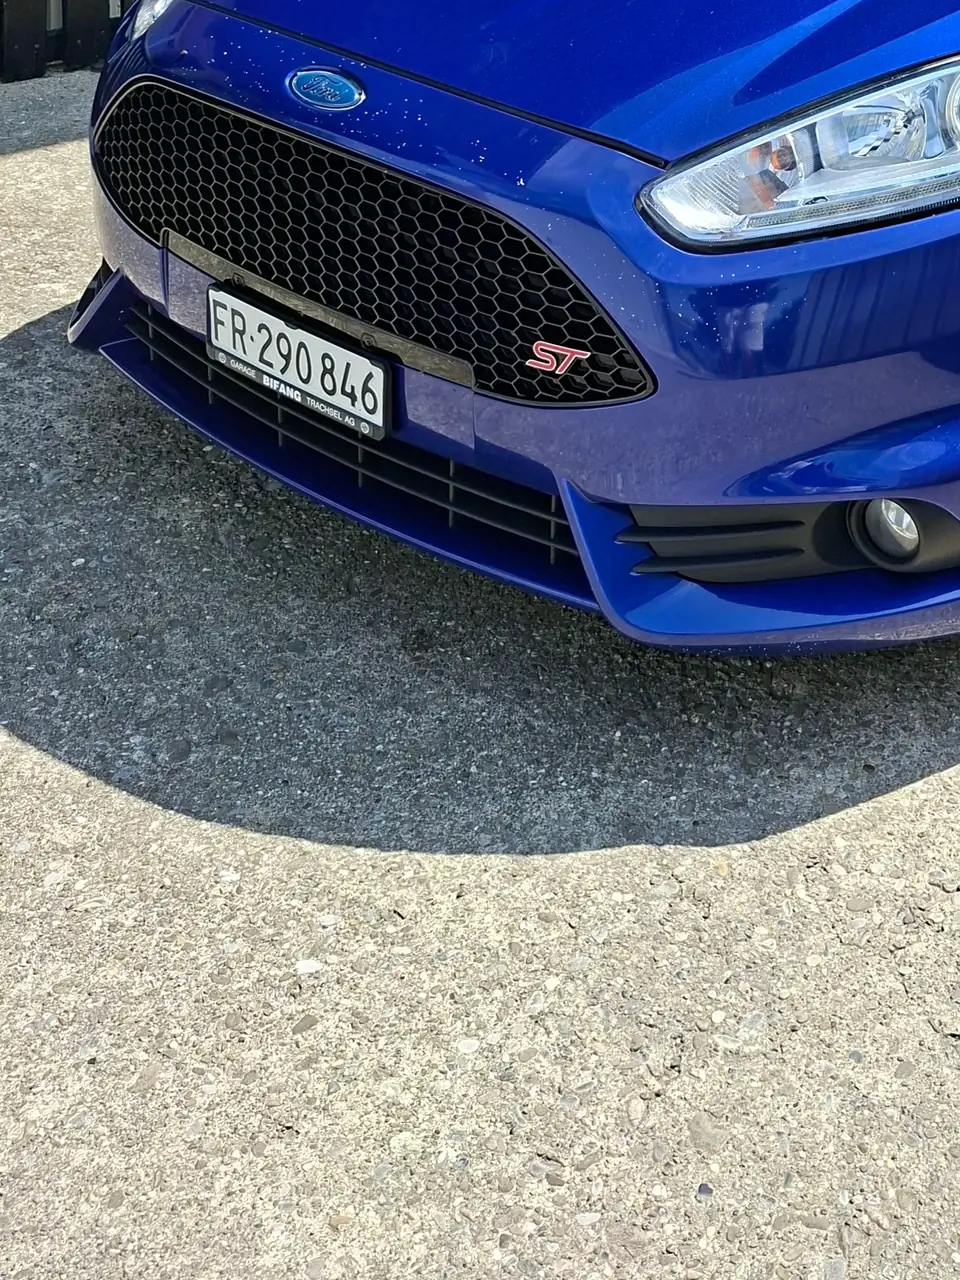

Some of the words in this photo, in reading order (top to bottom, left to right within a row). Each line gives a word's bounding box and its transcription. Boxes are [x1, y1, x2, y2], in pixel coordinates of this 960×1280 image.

[525, 340, 592, 375] ST
[230, 359, 257, 379] GARAGE
[262, 375, 302, 403] BIFANG
[306, 397, 343, 421] TRACHSEL
[344, 415, 356, 427] AG
